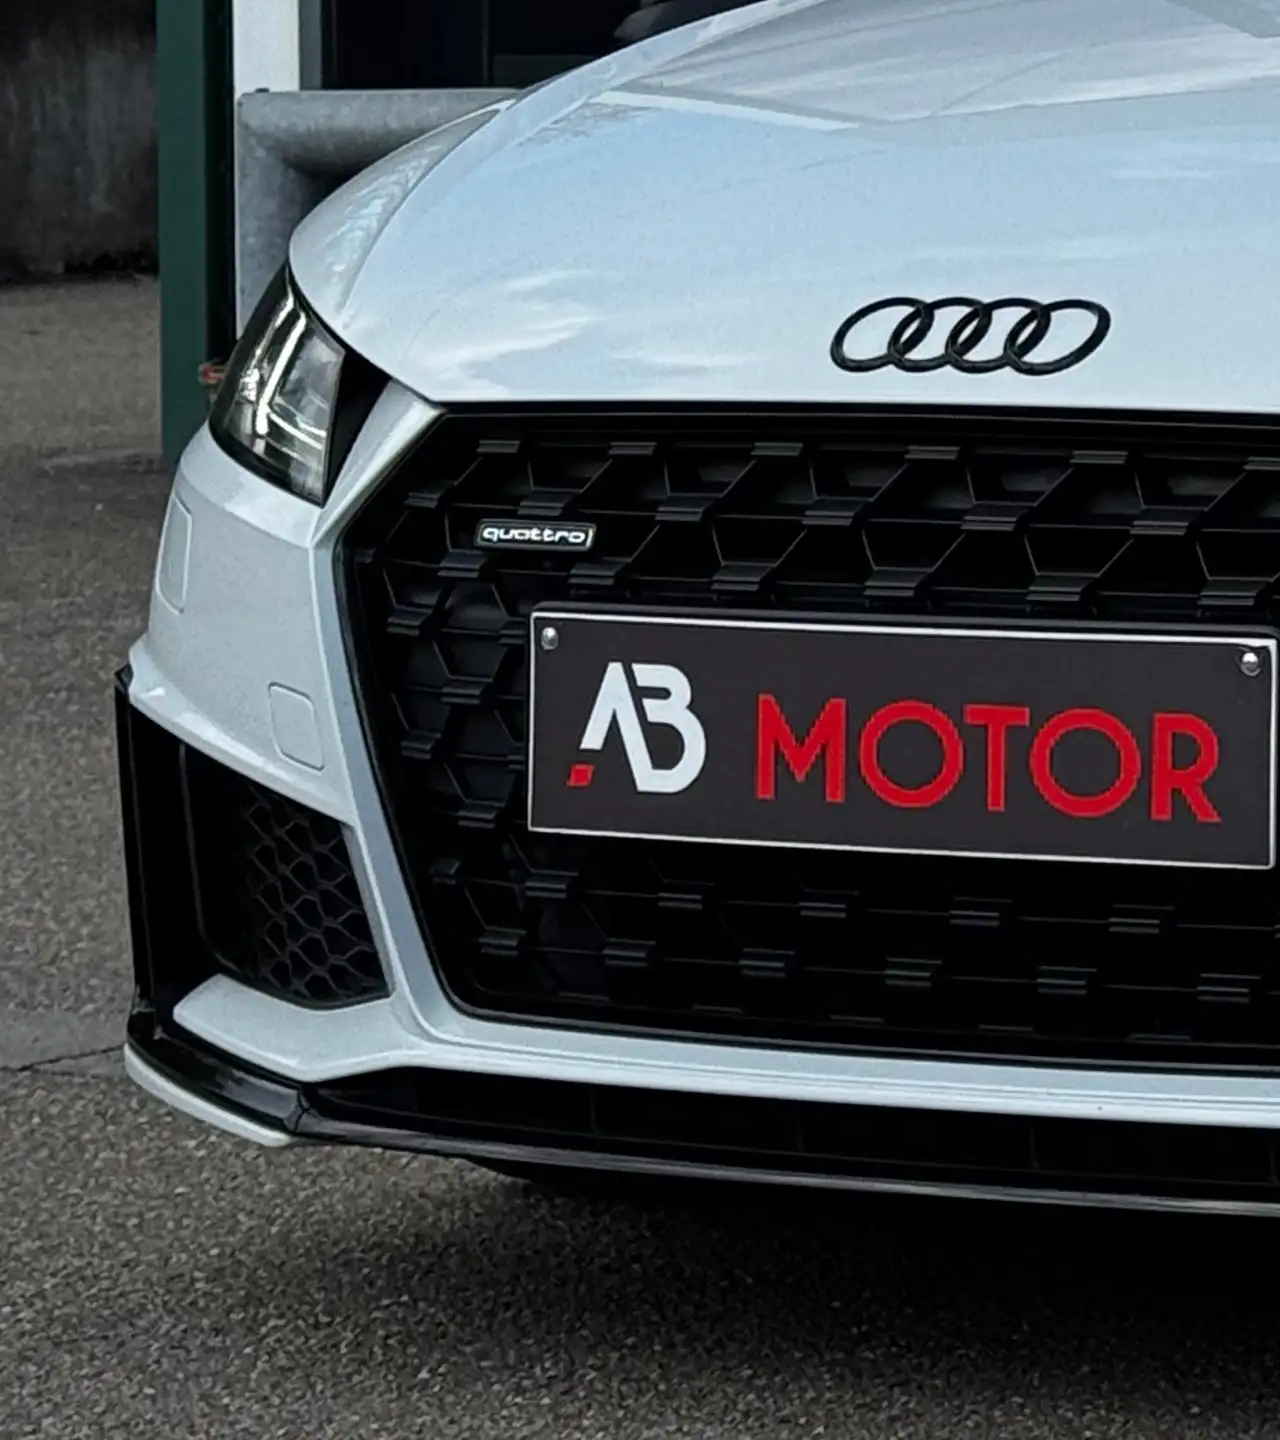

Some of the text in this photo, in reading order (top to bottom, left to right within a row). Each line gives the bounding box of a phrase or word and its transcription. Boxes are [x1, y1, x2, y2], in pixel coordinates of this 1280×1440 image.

[482, 526, 587, 544] quattro
[580, 662, 1222, 824] AB MOTOR
